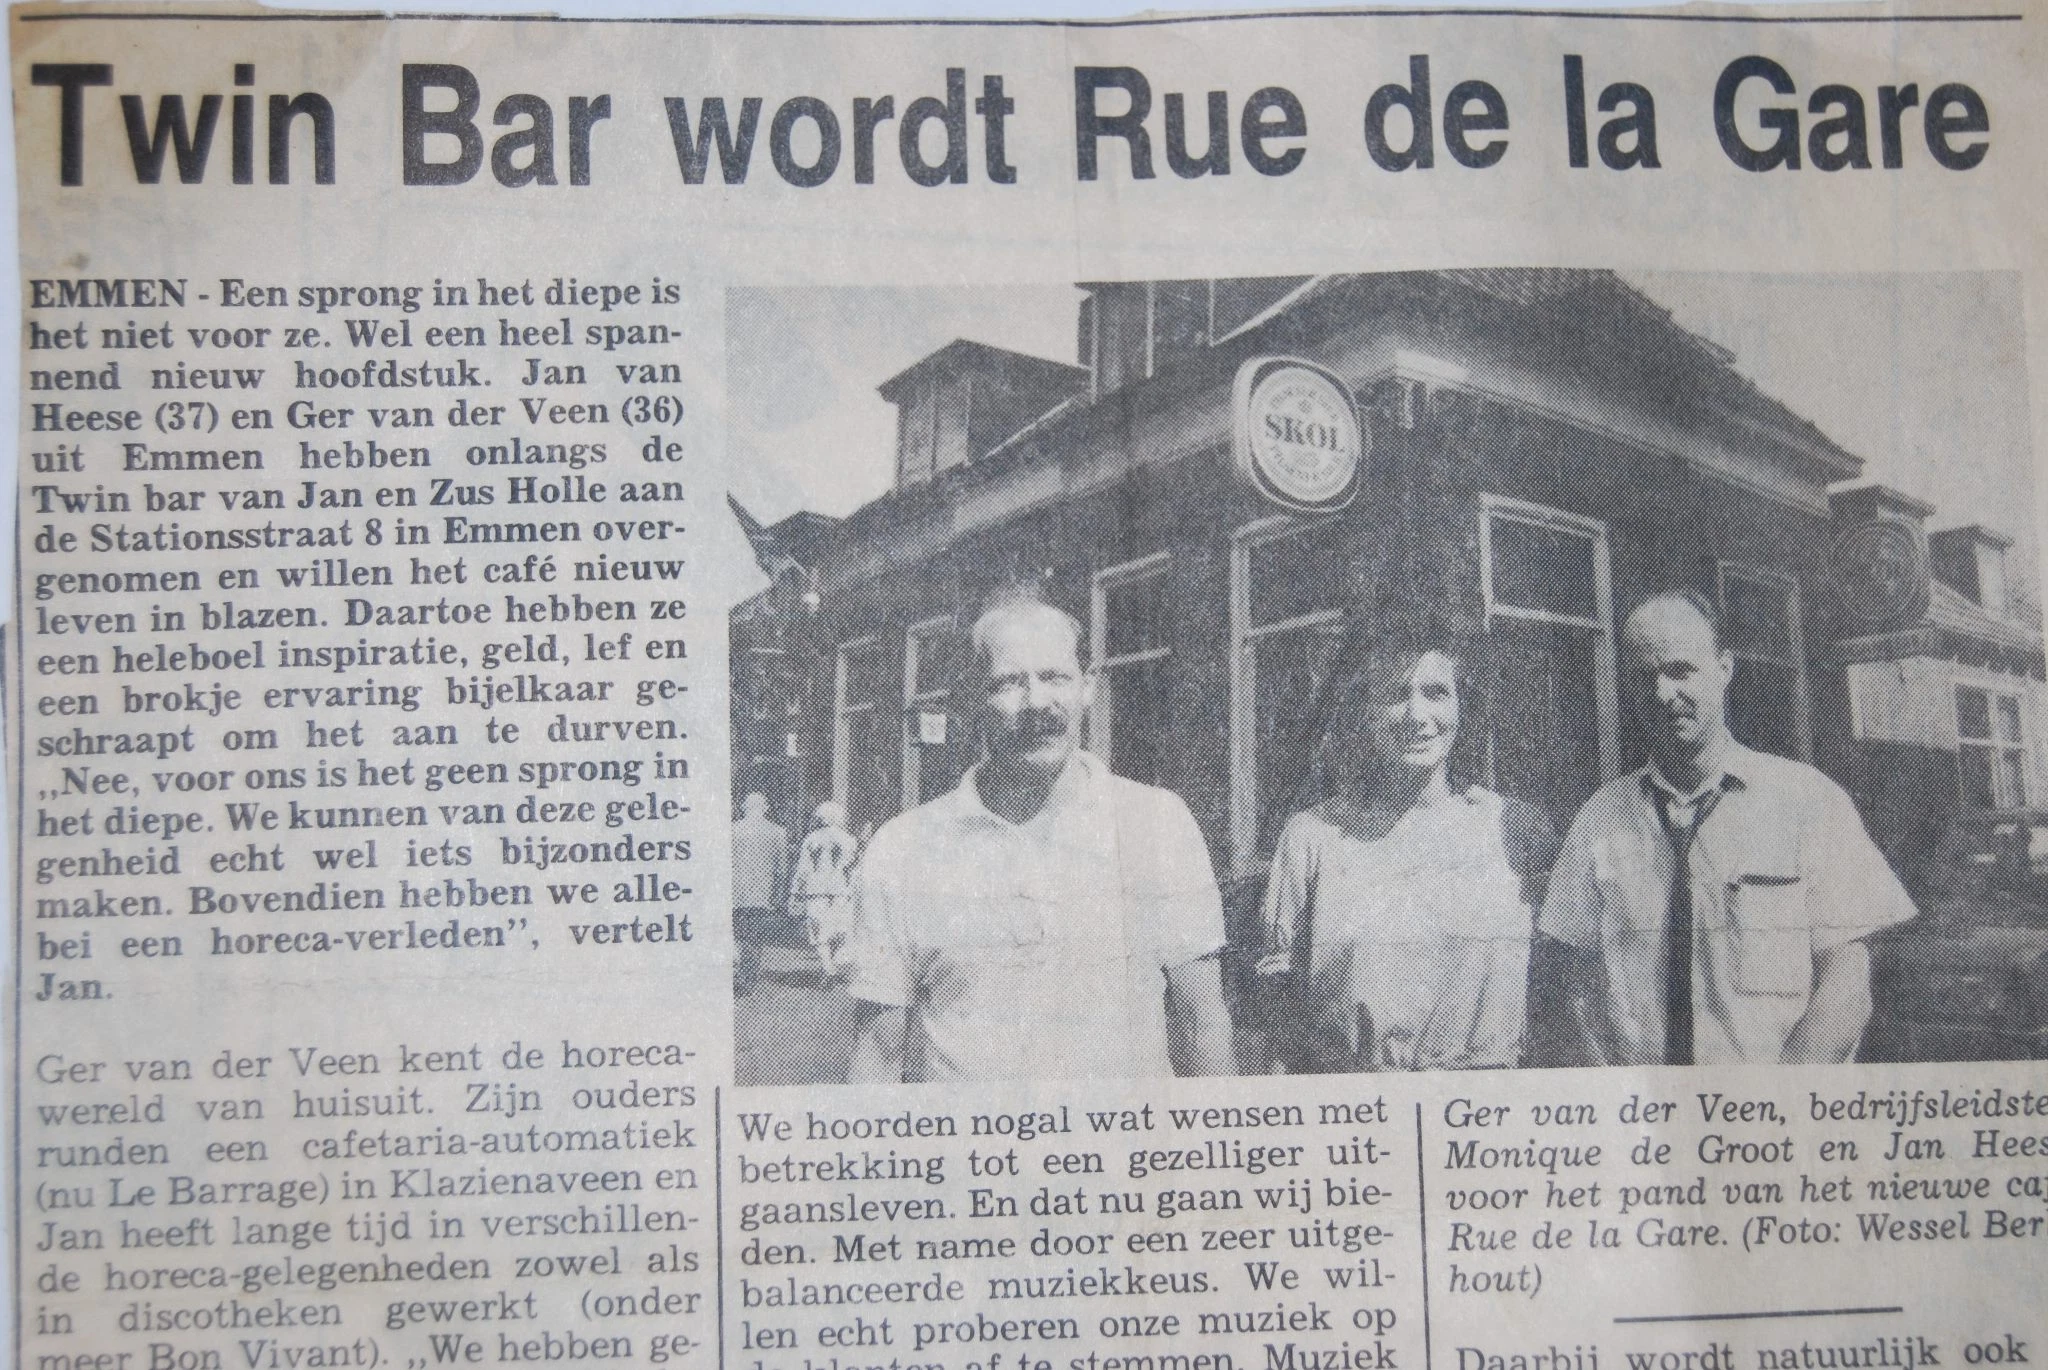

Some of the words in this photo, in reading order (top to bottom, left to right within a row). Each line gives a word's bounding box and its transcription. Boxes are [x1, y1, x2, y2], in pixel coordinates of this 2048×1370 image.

[31, 63, 335, 186] Twin
[403, 64, 611, 187] Bar
[664, 68, 1016, 187] wordt
[1075, 66, 1307, 180] Rue
[1365, 55, 1509, 172] de
[1564, 55, 1661, 170] la
[1714, 56, 1989, 172] Gare
[29, 279, 188, 308] EMMEN
[220, 279, 288, 307] Een
[298, 287, 423, 313] sprong
[433, 279, 469, 306] in
[477, 278, 534, 305] het
[545, 278, 640, 311] diepe
[652, 277, 680, 304] is
[29, 362, 121, 390] nend
[151, 362, 265, 389] nieuw
[294, 359, 491, 388] hoofdstuk.
[522, 359, 586, 385] Jan
[616, 364, 682, 384] van
[32, 445, 85, 472] uit
[122, 443, 264, 471] Emmen
[299, 441, 431, 468] hebben
[466, 437, 607, 469] onlangs
[642, 435, 683, 462] de
[1266, 414, 1345, 453] SKOL
[34, 525, 77, 553] de
[91, 520, 352, 552] Stationsstraat
[366, 518, 382, 545] 8
[395, 518, 430, 545] in
[444, 517, 581, 544] Emmen
[593, 521, 685, 541] over-
[36, 607, 136, 634] leven
[151, 605, 185, 631] in
[200, 602, 327, 630] blazen.
[344, 598, 491, 626] Daartoe
[505, 594, 636, 622] hebben
[651, 600, 686, 619] ze
[38, 695, 98, 716] een
[122, 683, 241, 716] brokje
[264, 679, 422, 712] ervaring
[445, 675, 614, 710] bijelkaar
[636, 680, 688, 706] ge-
[38, 725, 194, 759] schraapt
[223, 730, 278, 750] om
[306, 720, 364, 747] het
[393, 726, 458, 745] aan
[486, 717, 519, 743] te
[548, 714, 687, 742] durven.
[37, 809, 93, 836] het
[105, 807, 213, 840] diepe.
[225, 803, 278, 831] We
[289, 801, 428, 829] kunnen
[438, 804, 505, 825] van
[517, 795, 595, 823] deze
[605, 792, 691, 827] gele-
[37, 890, 171, 918] maken.
[189, 883, 385, 914] Bovendien
[400, 878, 533, 908] hebben
[547, 884, 598, 904] we
[614, 874, 692, 903] alle-
[36, 974, 112, 1001] Jan.
[37, 1055, 106, 1083] Ger
[124, 1060, 192, 1081] van
[213, 1050, 272, 1079] der
[289, 1048, 380, 1076] Veen
[400, 1043, 481, 1072] kent
[503, 1041, 543, 1069] de
[562, 1040, 696, 1068] horeca-
[737, 1113, 792, 1141] We
[806, 1111, 957, 1140] hoorden
[971, 1106, 1072, 1140] nogal
[1086, 1103, 1154, 1132] wat
[1168, 1106, 1304, 1129] wensen
[1319, 1096, 1388, 1124] met
[1444, 1099, 1510, 1128] Ger
[1531, 1105, 1597, 1126] van
[1619, 1095, 1677, 1124] der
[1696, 1094, 1785, 1125] Veen,
[38, 1138, 168, 1167] runden
[206, 1141, 267, 1162] een
[303, 1120, 696, 1159] cafetaria-automatiek
[738, 1151, 944, 1184] betrekking
[968, 1148, 1019, 1176] tot
[1043, 1154, 1104, 1174] een
[1128, 1140, 1304, 1178] gezelliger
[1327, 1136, 1390, 1165] uit-
[1444, 1139, 1601, 1175] Monique
[1631, 1137, 1671, 1165] de
[1698, 1135, 1793, 1164] Groot
[1820, 1141, 1858, 1161] en
[1884, 1132, 1945, 1160] Jan
[37, 1184, 92, 1211] (nu
[109, 1179, 154, 1207] Le
[169, 1176, 328, 1208] Barrage)
[342, 1172, 376, 1199] in
[391, 1167, 642, 1198] Klazienaveen
[656, 1169, 697, 1189] en
[740, 1194, 955, 1231] gaansleven.
[968, 1189, 1019, 1217] En
[1030, 1187, 1088, 1216] dat
[1099, 1193, 1144, 1213] nu
[1157, 1190, 1243, 1218] gaan
[1254, 1179, 1311, 1214] wij
[1323, 1177, 1392, 1206] bie-
[1446, 1189, 1528, 1210] voor
[1547, 1181, 1601, 1208] het
[1619, 1177, 1706, 1214] pand
[1722, 1184, 1783, 1204] van
[1800, 1175, 1852, 1202] het
[1867, 1172, 1990, 1200] nieuwe
[37, 1223, 103, 1251] Jan
[121, 1219, 214, 1248] heeft
[233, 1217, 330, 1249] lange
[347, 1212, 410, 1247] tijd
[430, 1211, 464, 1238] in
[481, 1204, 698, 1237] verschillen-
[741, 1238, 815, 1265] den.
[833, 1235, 902, 1262] Met
[916, 1238, 1015, 1259] name
[1031, 1228, 1114, 1256] door
[1127, 1232, 1188, 1253] een
[1202, 1229, 1275, 1250] zeer
[1288, 1219, 1393, 1253] uitge-
[1448, 1223, 1516, 1251] Rue
[1533, 1222, 1572, 1249] de
[1589, 1220, 1621, 1248] la
[1637, 1219, 1727, 1247] Gare.
[1743, 1216, 1840, 1253] (Foto:
[1856, 1211, 1970, 1241] Wessel
[38, 1265, 79, 1293] de
[105, 1253, 490, 1293] horeca-gelegenheden
[516, 1246, 621, 1277] zowel
[648, 1245, 698, 1273] als
[1450, 1264, 1541, 1299] hout)
[38, 1307, 72, 1334] in
[119, 1299, 341, 1331] discotheken
[386, 1292, 537, 1330] gewerkt
[582, 1286, 701, 1318] (onder
[743, 1321, 798, 1349] len
[818, 1318, 893, 1347] echt
[913, 1313, 1080, 1351] proberen
[1100, 1315, 1179, 1337] onze
[1199, 1302, 1332, 1334] muziek
[1353, 1309, 1396, 1336] op
